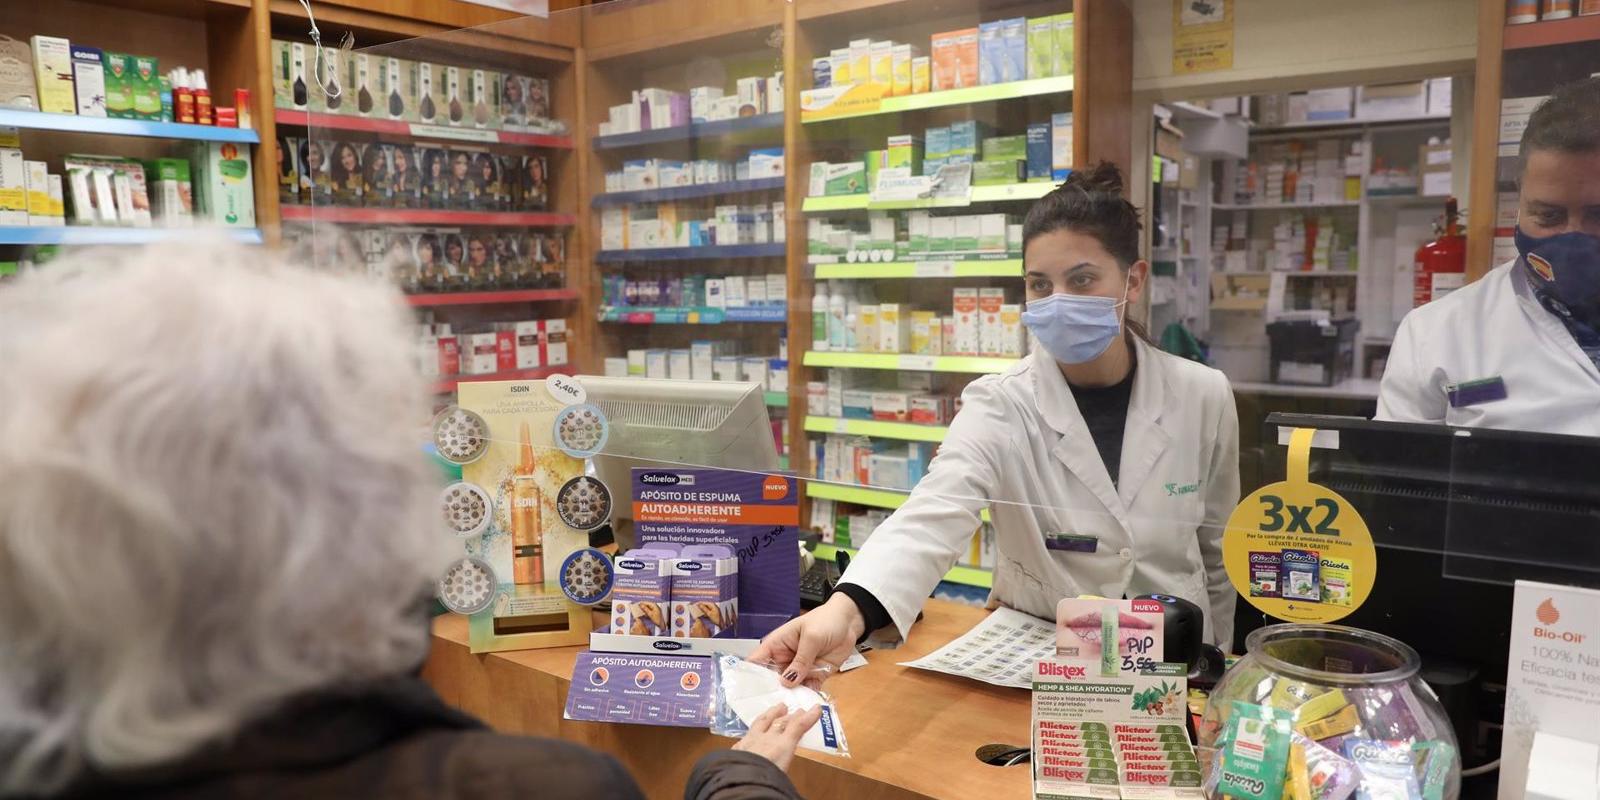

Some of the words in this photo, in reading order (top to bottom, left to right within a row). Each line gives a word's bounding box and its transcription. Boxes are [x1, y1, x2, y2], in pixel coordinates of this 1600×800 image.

[554, 380, 580, 397] 2,40€
[643, 474, 676, 483] Salvelox
[640, 490, 681, 500] APÓSITO
[684, 492, 697, 501] DE
[700, 493, 741, 502] ESPUMA
[641, 504, 741, 516] AUTOADHERENTE
[1260, 495, 1340, 536] 3x2
[1283, 552, 1317, 563] Ricola
[1320, 560, 1350, 570] Ricola
[1534, 627, 1582, 643] Bio-Oil
[1533, 646, 1572, 662] 100%
[592, 657, 627, 666] APÓSITO
[628, 659, 703, 670] AUTOADHERENTE
[1039, 662, 1085, 680] Blistex
[1521, 660, 1576, 680] Eficacia
[1043, 766, 1084, 781] Blistex
[1126, 771, 1168, 784] Blistex
[1223, 772, 1264, 794] Ricola
